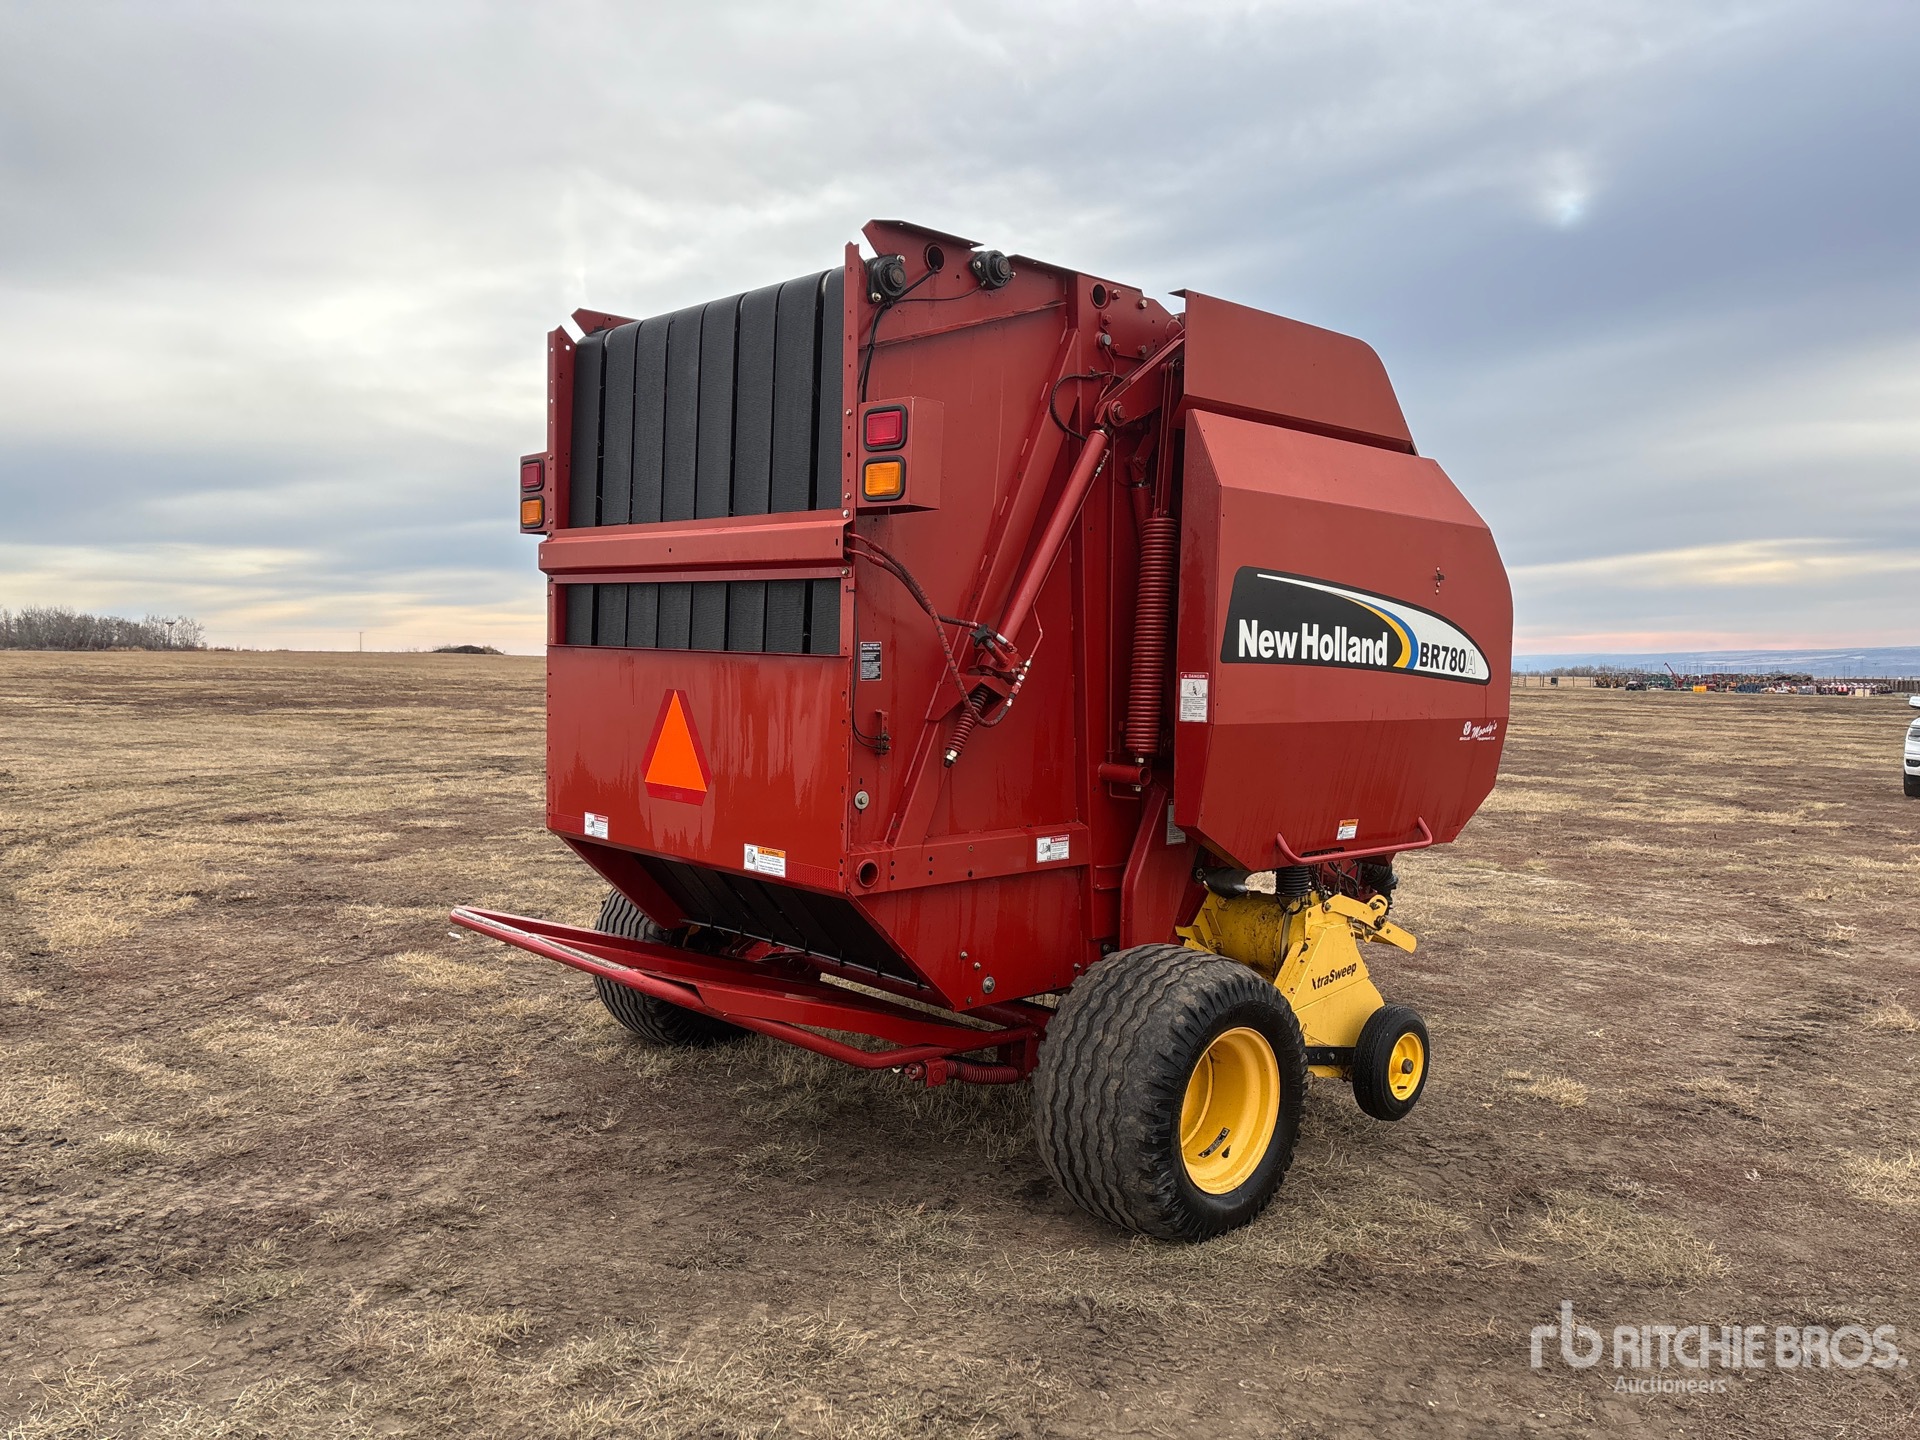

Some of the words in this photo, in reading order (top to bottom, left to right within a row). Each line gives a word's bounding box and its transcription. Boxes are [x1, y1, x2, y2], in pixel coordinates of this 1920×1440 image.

[1238, 619, 1298, 659] New
[1301, 622, 1388, 666] Holland
[1419, 642, 1476, 674] BR780A
